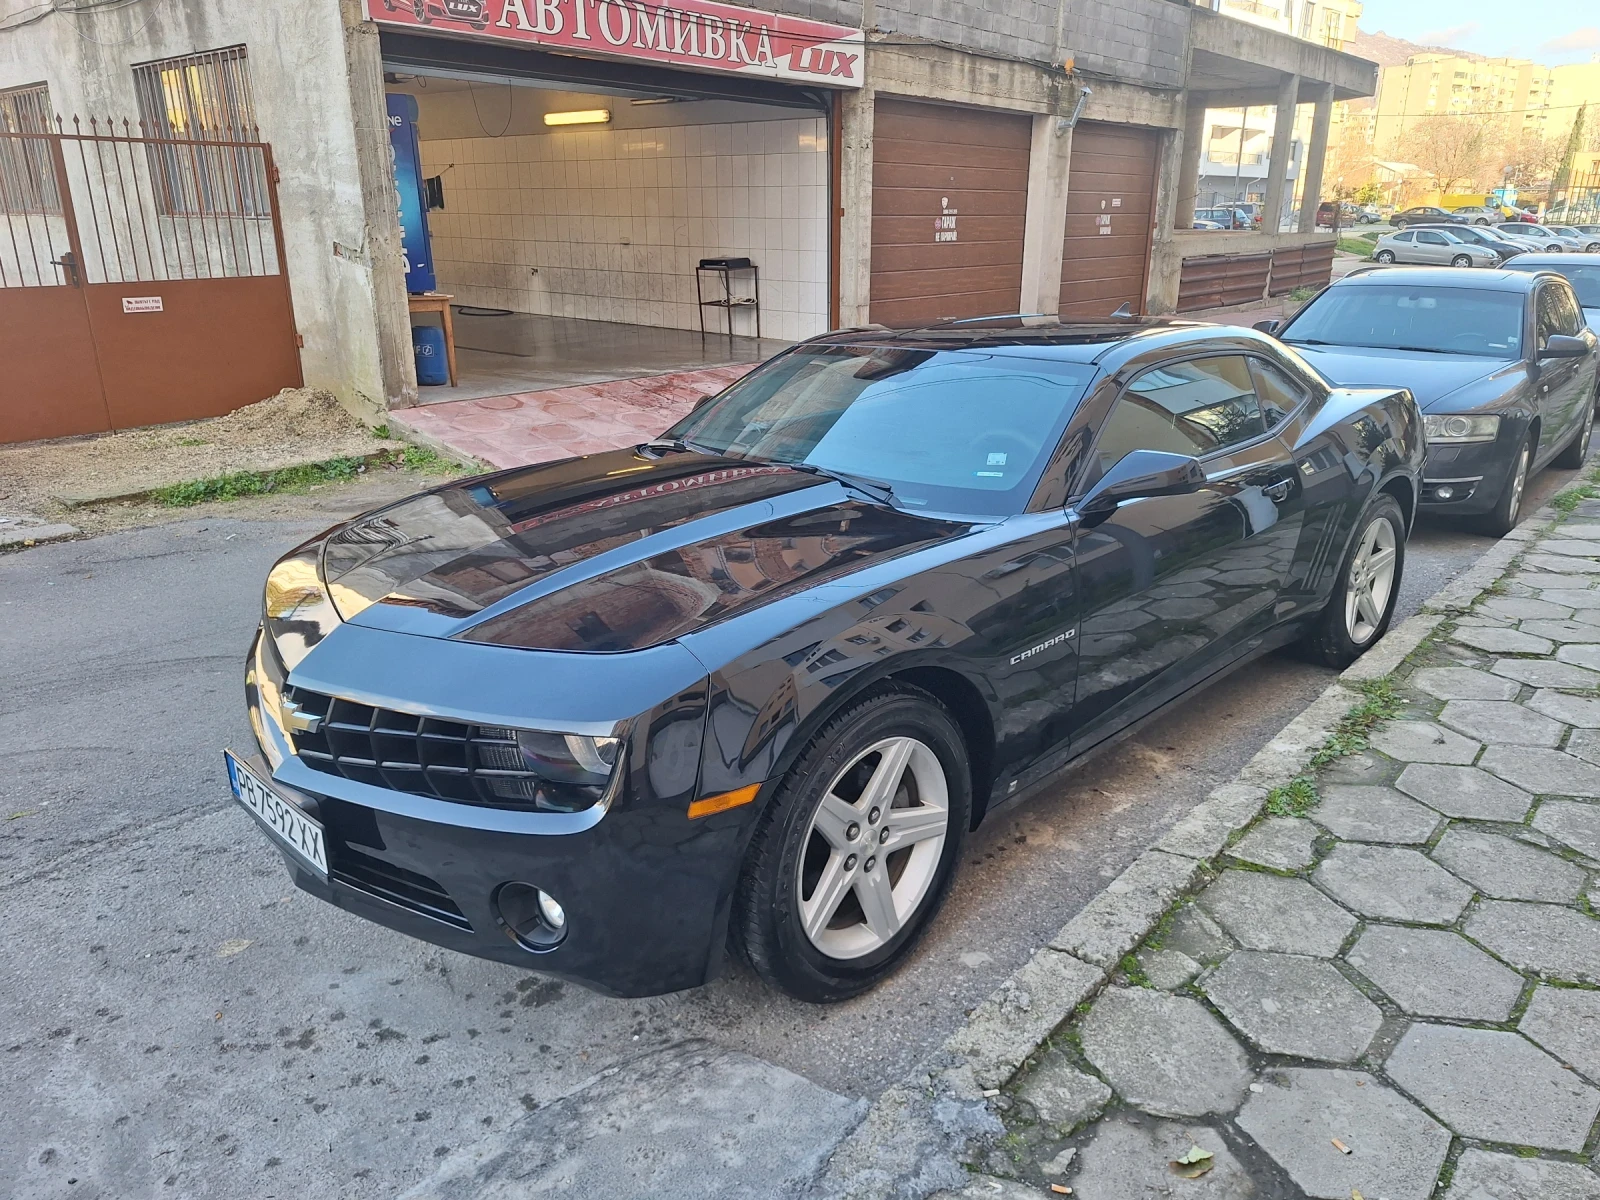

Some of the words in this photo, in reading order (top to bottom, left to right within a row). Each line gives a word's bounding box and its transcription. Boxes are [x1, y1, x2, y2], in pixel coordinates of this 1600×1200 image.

[448, 2, 478, 13] LUX
[495, 0, 778, 69] АВТОМИВКА
[788, 44, 858, 79] LUX
[1009, 628, 1076, 666] CAMARO
